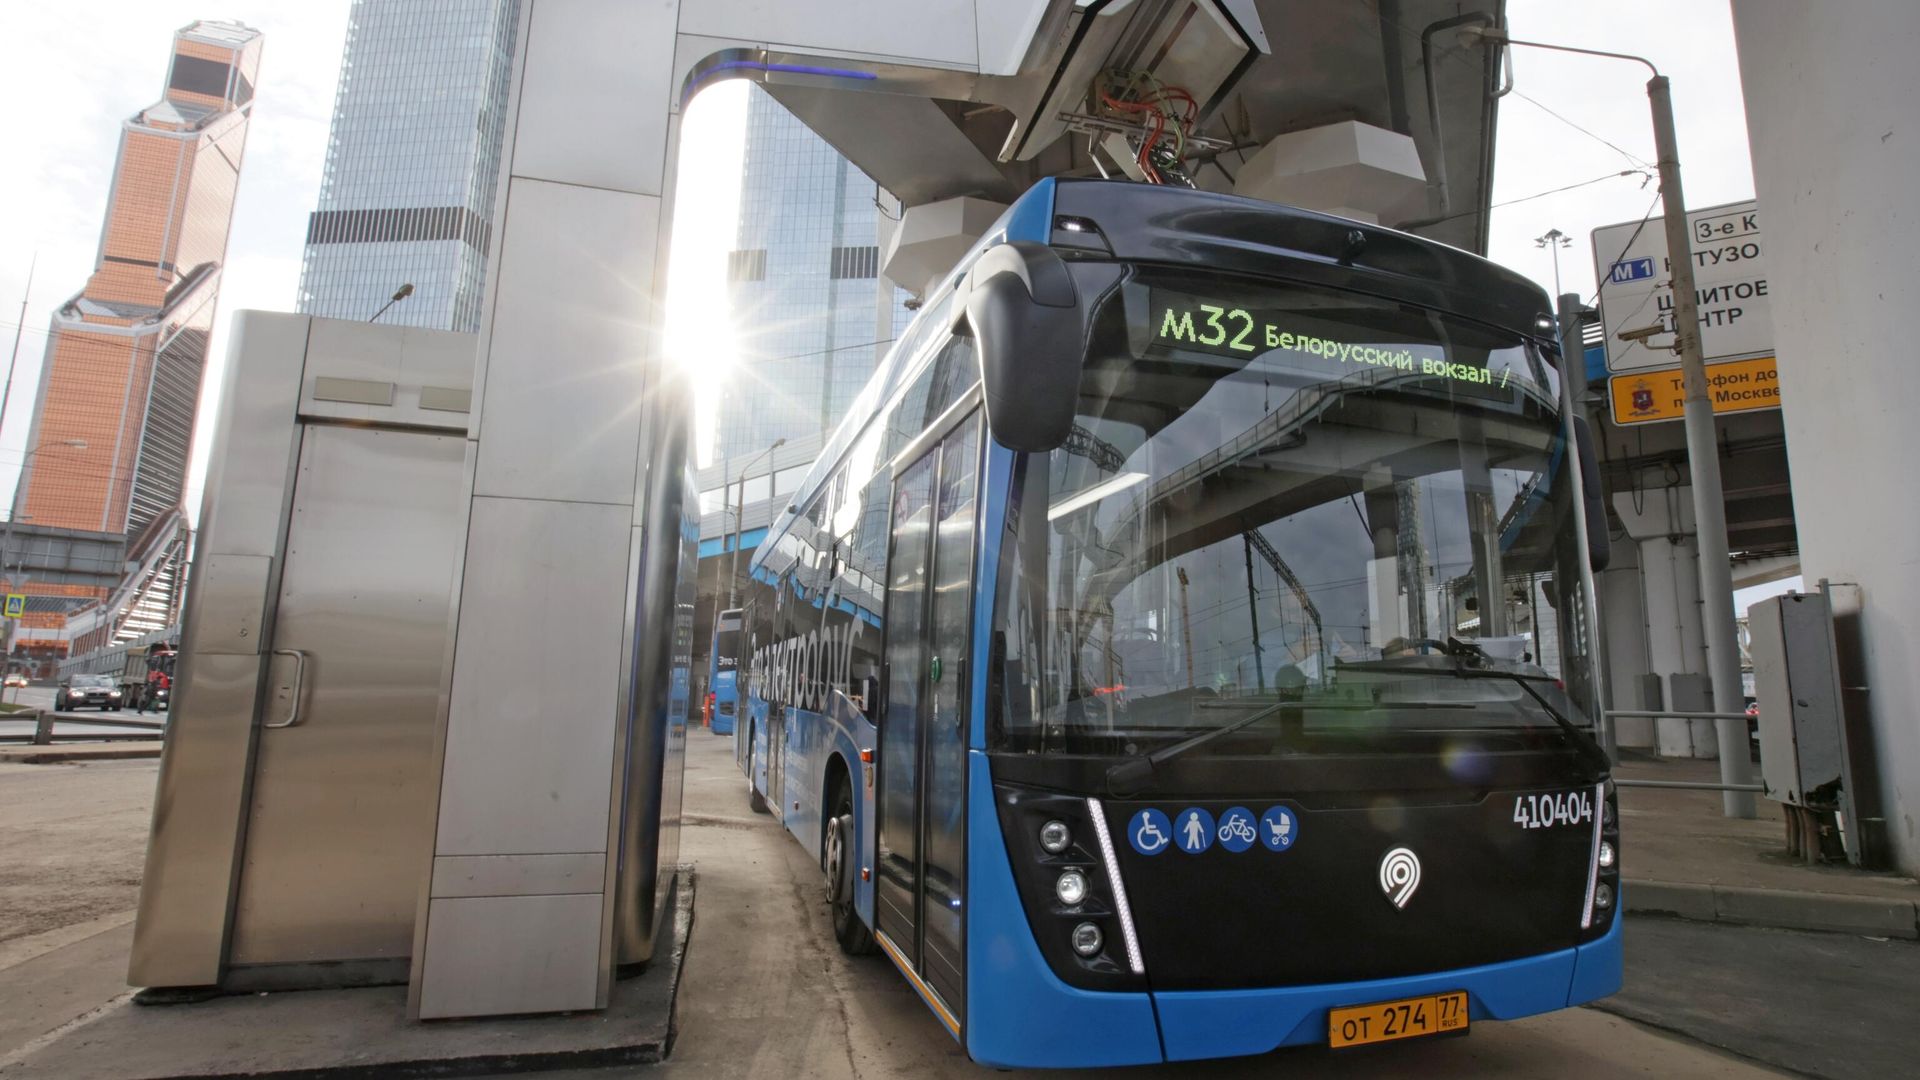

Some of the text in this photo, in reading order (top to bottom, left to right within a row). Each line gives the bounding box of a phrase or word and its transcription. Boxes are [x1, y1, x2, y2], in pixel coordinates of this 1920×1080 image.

[1699, 222, 1735, 239] 3-е
[1665, 243, 1759, 272] ТУЗО
[1659, 307, 1743, 335] ЦНТР
[1265, 324, 1413, 372] Белорусский
[1422, 357, 1491, 385] вокзал
[1670, 370, 1749, 391] Тефон
[1716, 385, 1780, 403] Москве
[1513, 791, 1592, 830] 410404
[1383, 1003, 1426, 1036] 274
[1439, 996, 1460, 1019] 77
[1442, 1018, 1458, 1027] RUS
